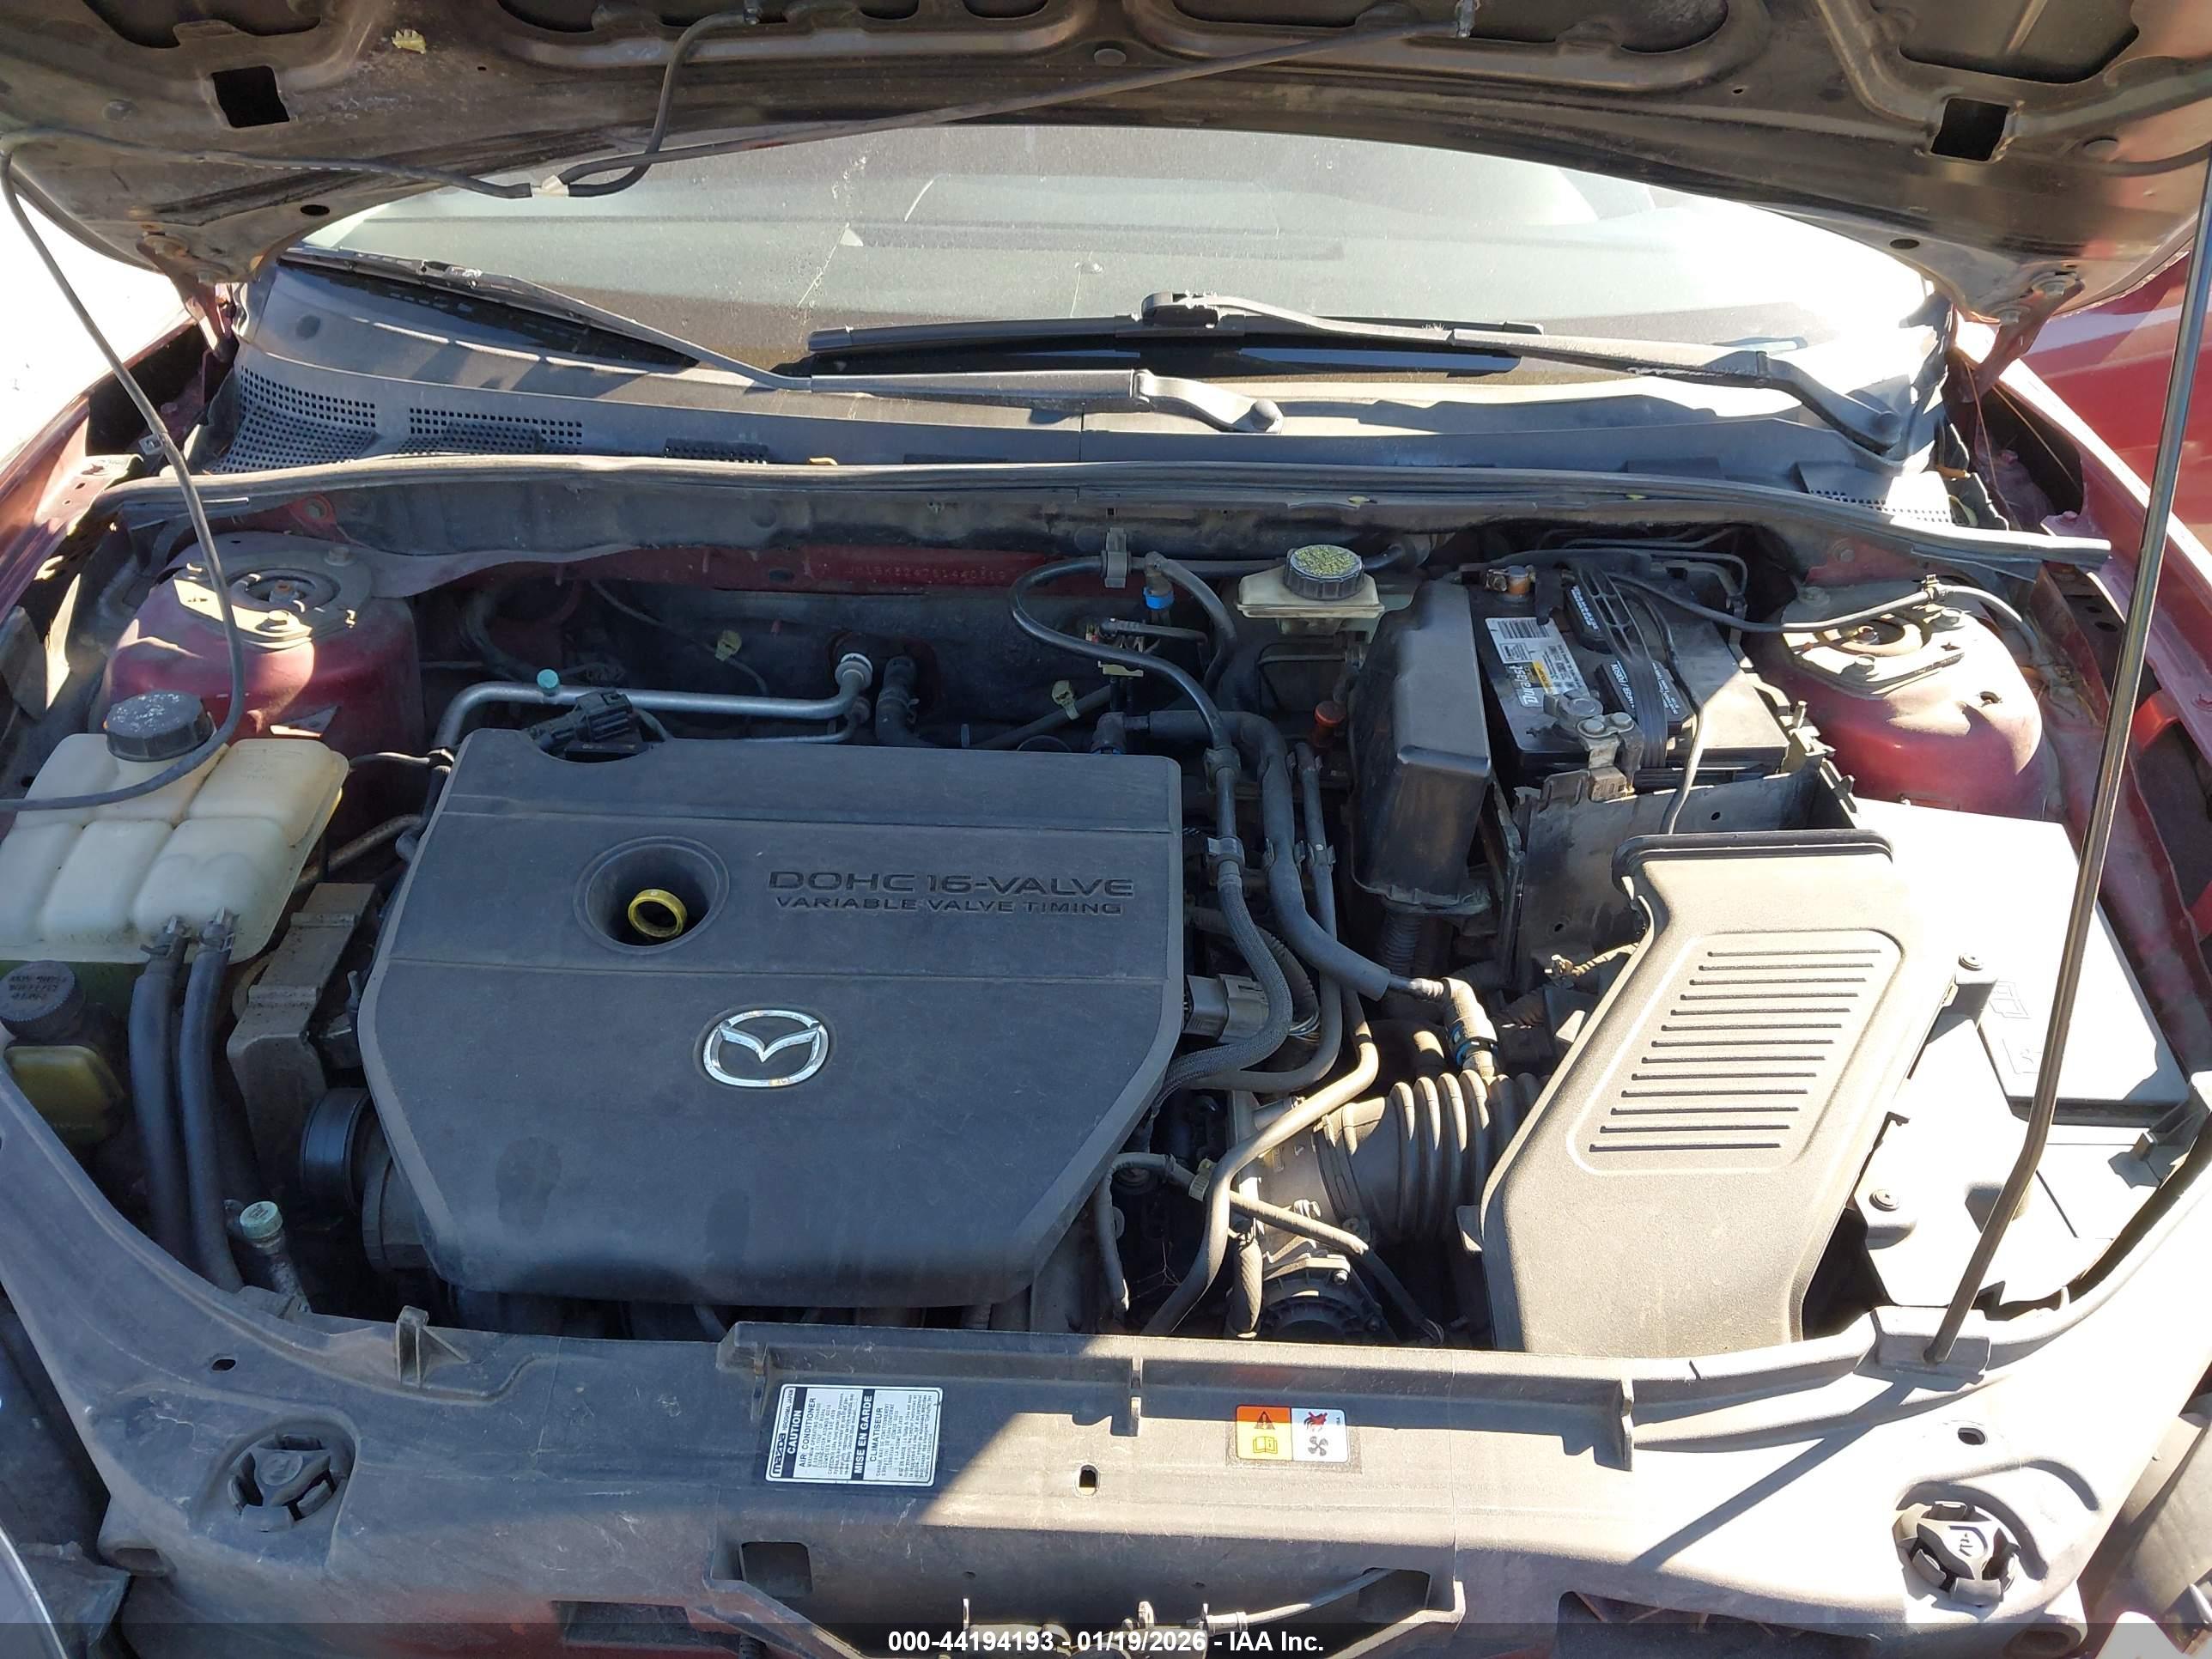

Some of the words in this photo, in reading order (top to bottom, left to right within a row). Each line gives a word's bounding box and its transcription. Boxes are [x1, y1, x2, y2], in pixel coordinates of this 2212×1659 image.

[1509, 665, 1540, 705] Duralast
[769, 872, 916, 892] DOHC
[927, 874, 1133, 896] 16-VALVE
[775, 897, 916, 910] VARIABLE
[927, 899, 1013, 912] VALVE
[1023, 901, 1121, 915] TIMING
[802, 1397, 816, 1449] CONDITIONER
[860, 1395, 872, 1430] GARDE
[787, 1410, 802, 1454] CAUTION
[858, 1432, 867, 1446] EN
[870, 1407, 883, 1462] CLIMATISEUR
[854, 1449, 865, 1474] MISE
